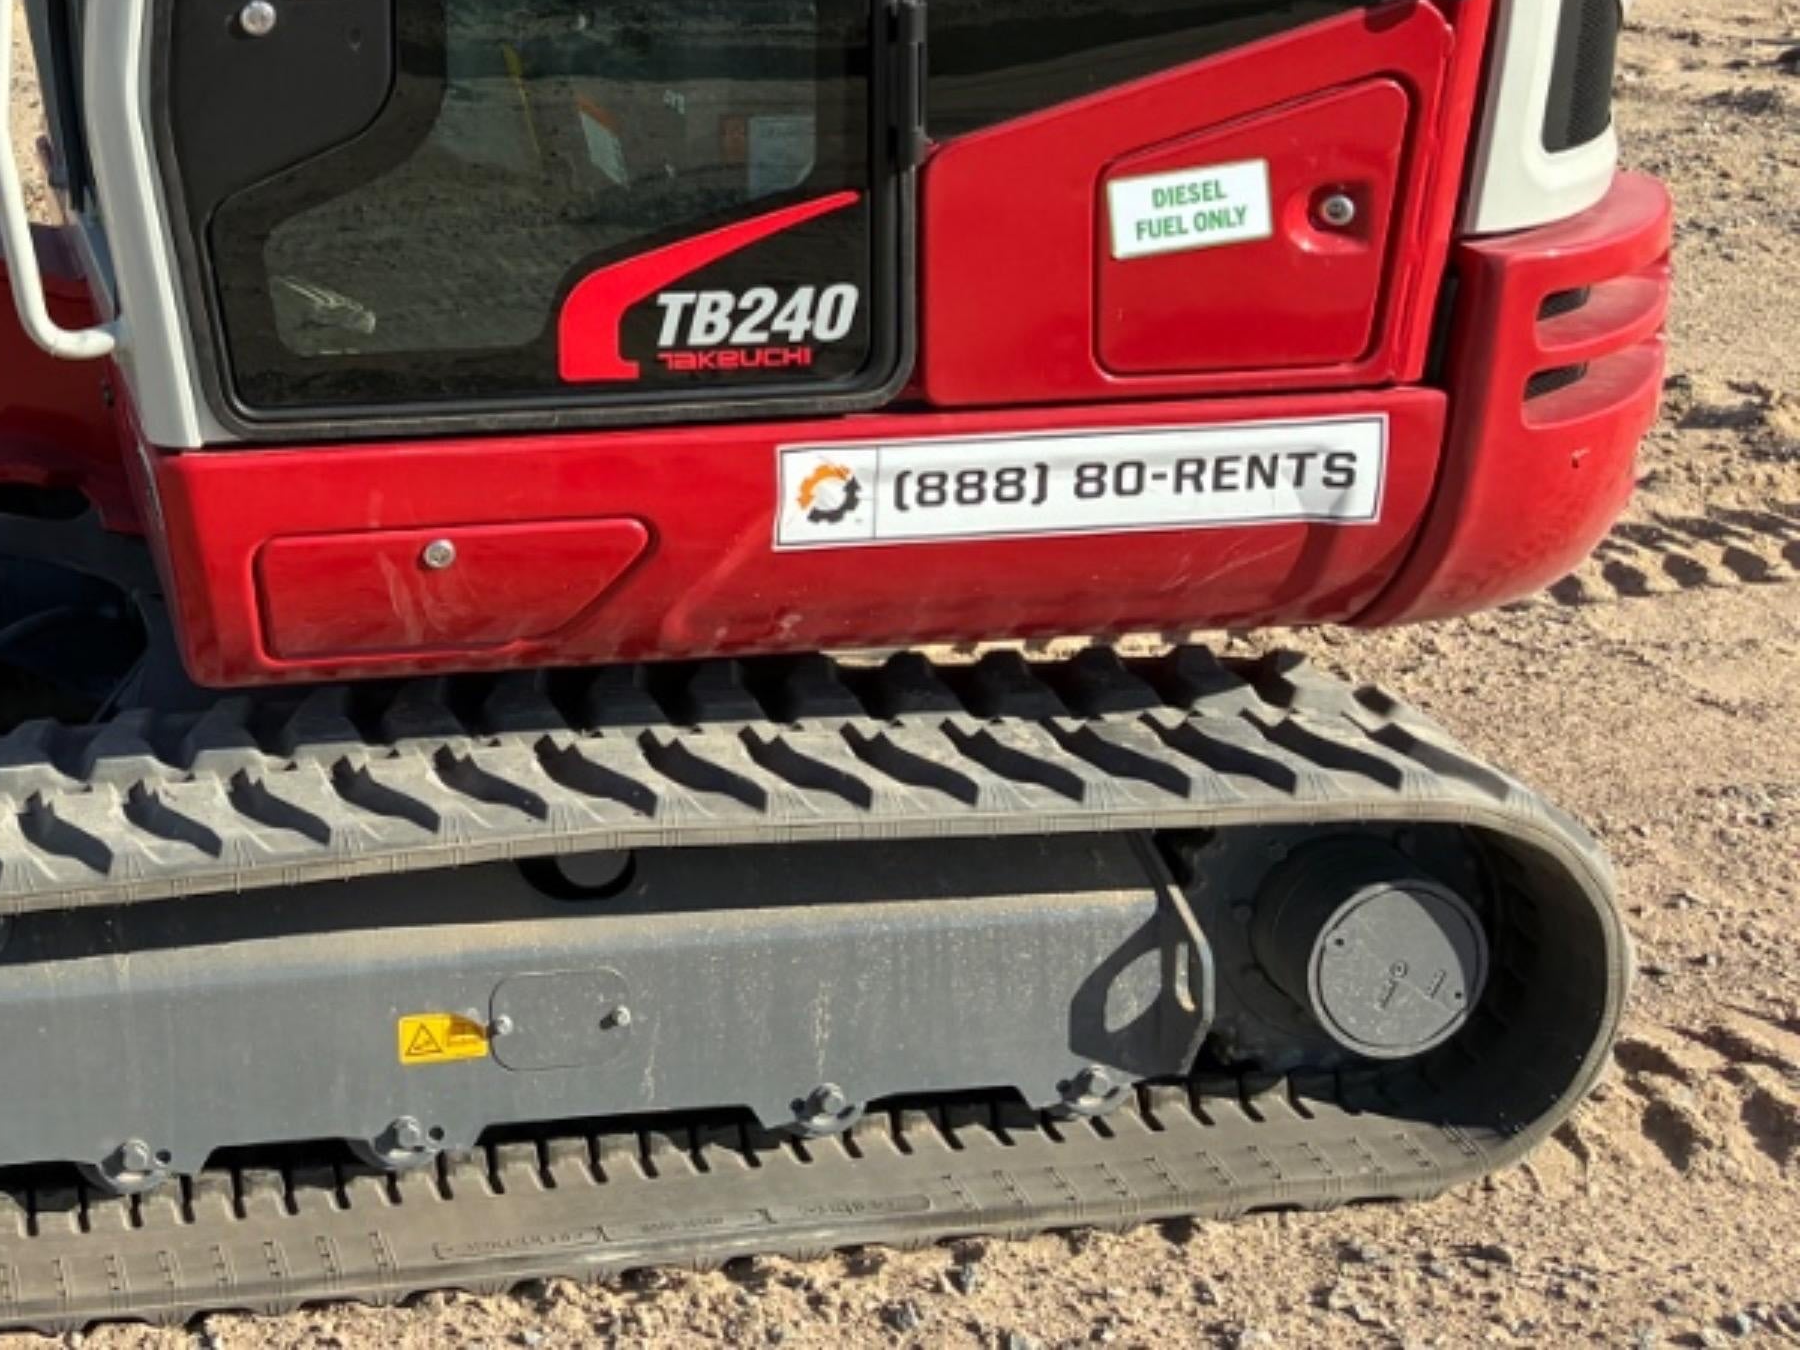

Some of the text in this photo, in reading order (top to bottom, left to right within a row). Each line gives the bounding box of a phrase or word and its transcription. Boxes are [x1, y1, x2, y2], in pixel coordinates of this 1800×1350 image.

[1152, 178, 1229, 209] DIESEL
[1135, 205, 1248, 241] FUEL ONLY
[656, 282, 860, 348] TB240
[893, 451, 1358, 511] (888) 80-RENTS
